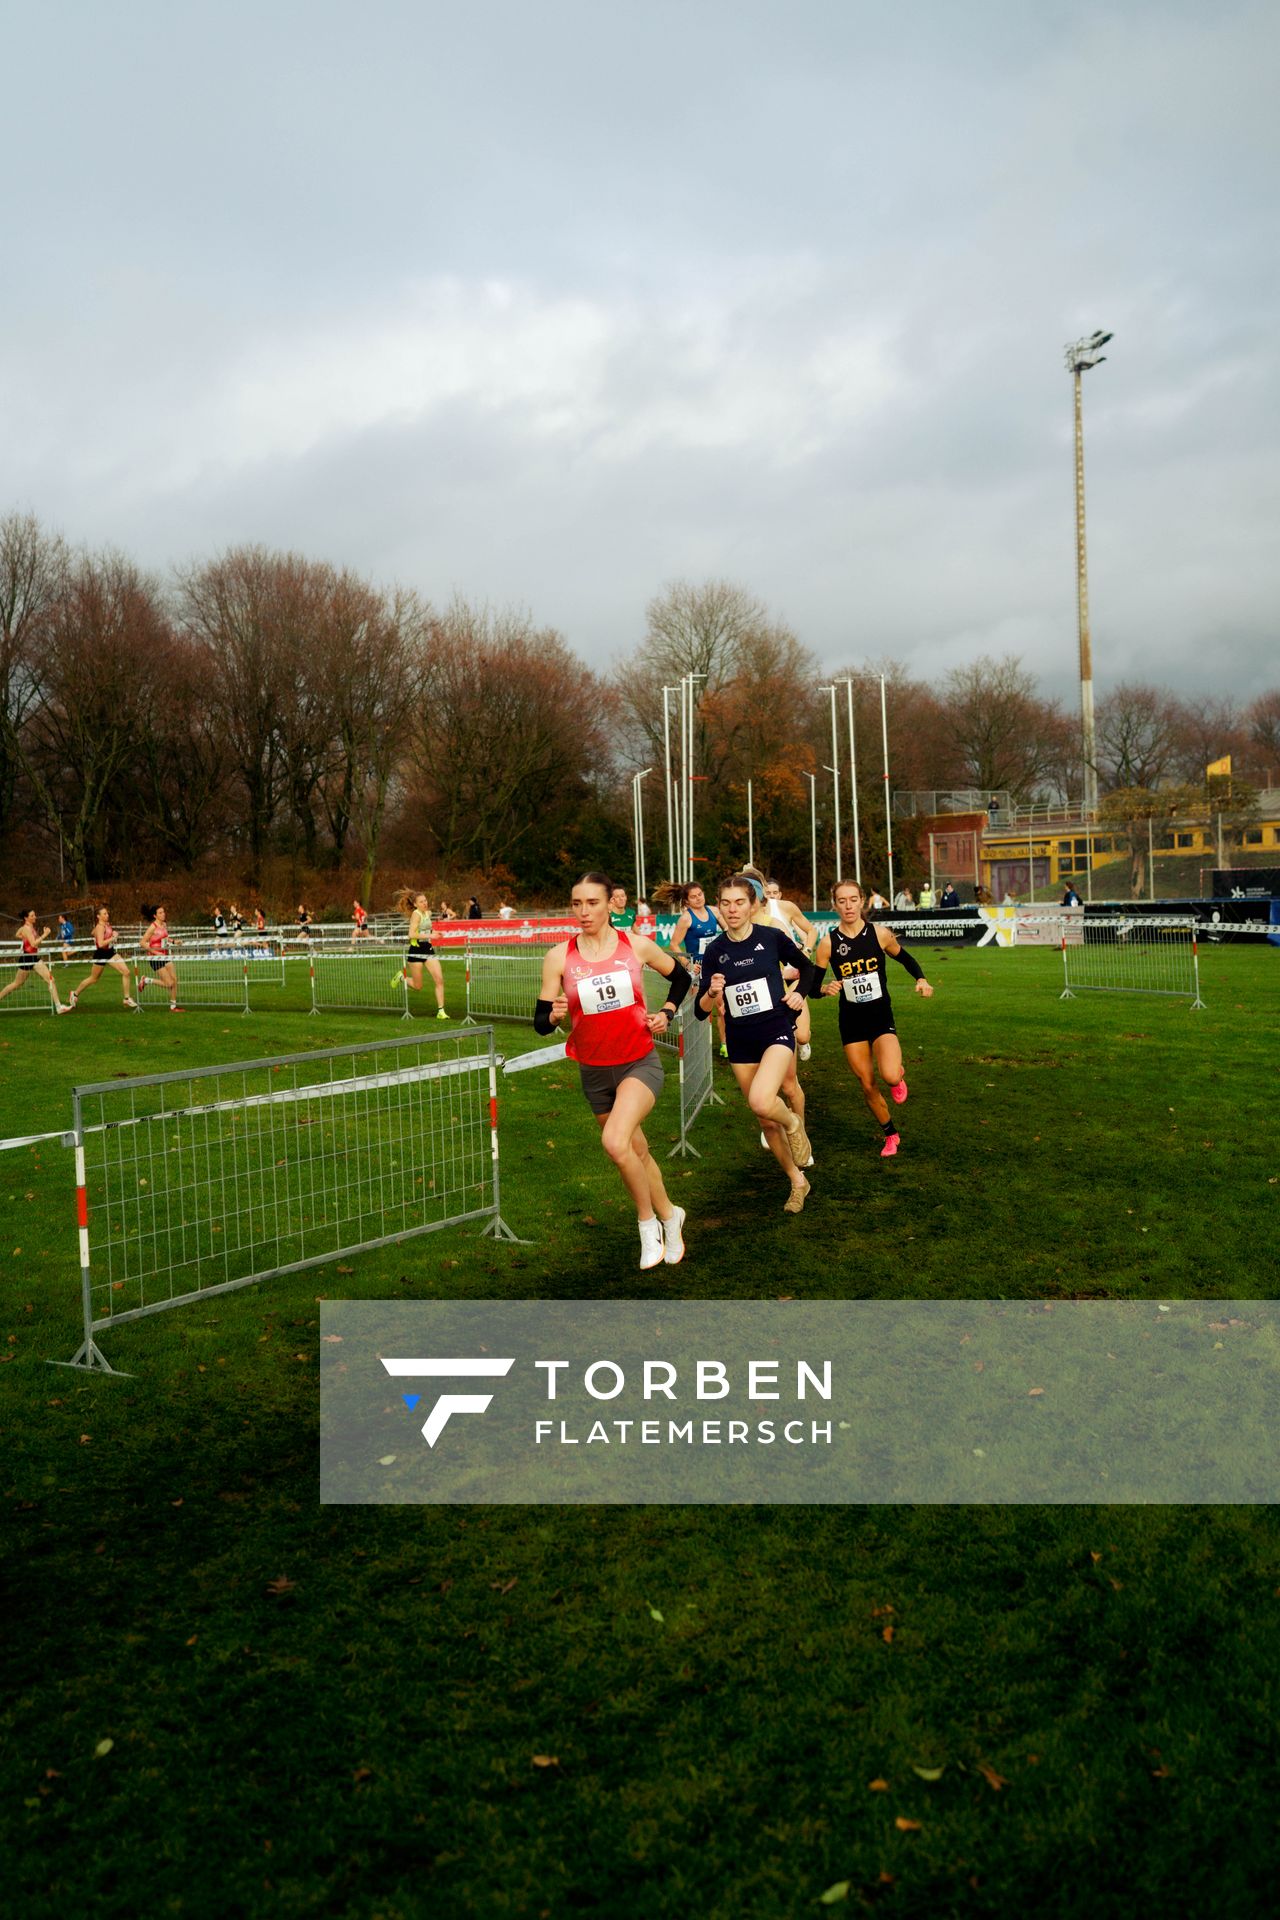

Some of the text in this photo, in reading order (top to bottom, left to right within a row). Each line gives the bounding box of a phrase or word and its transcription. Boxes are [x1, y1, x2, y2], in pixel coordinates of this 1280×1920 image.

[905, 929, 964, 938] MEISTERSCHAFTEN
[839, 957, 878, 977] BTC
[592, 975, 612, 986] GLS
[596, 985, 617, 1001] 19
[735, 983, 752, 993] GLS
[851, 982, 873, 995] 104
[735, 990, 759, 1007] 691
